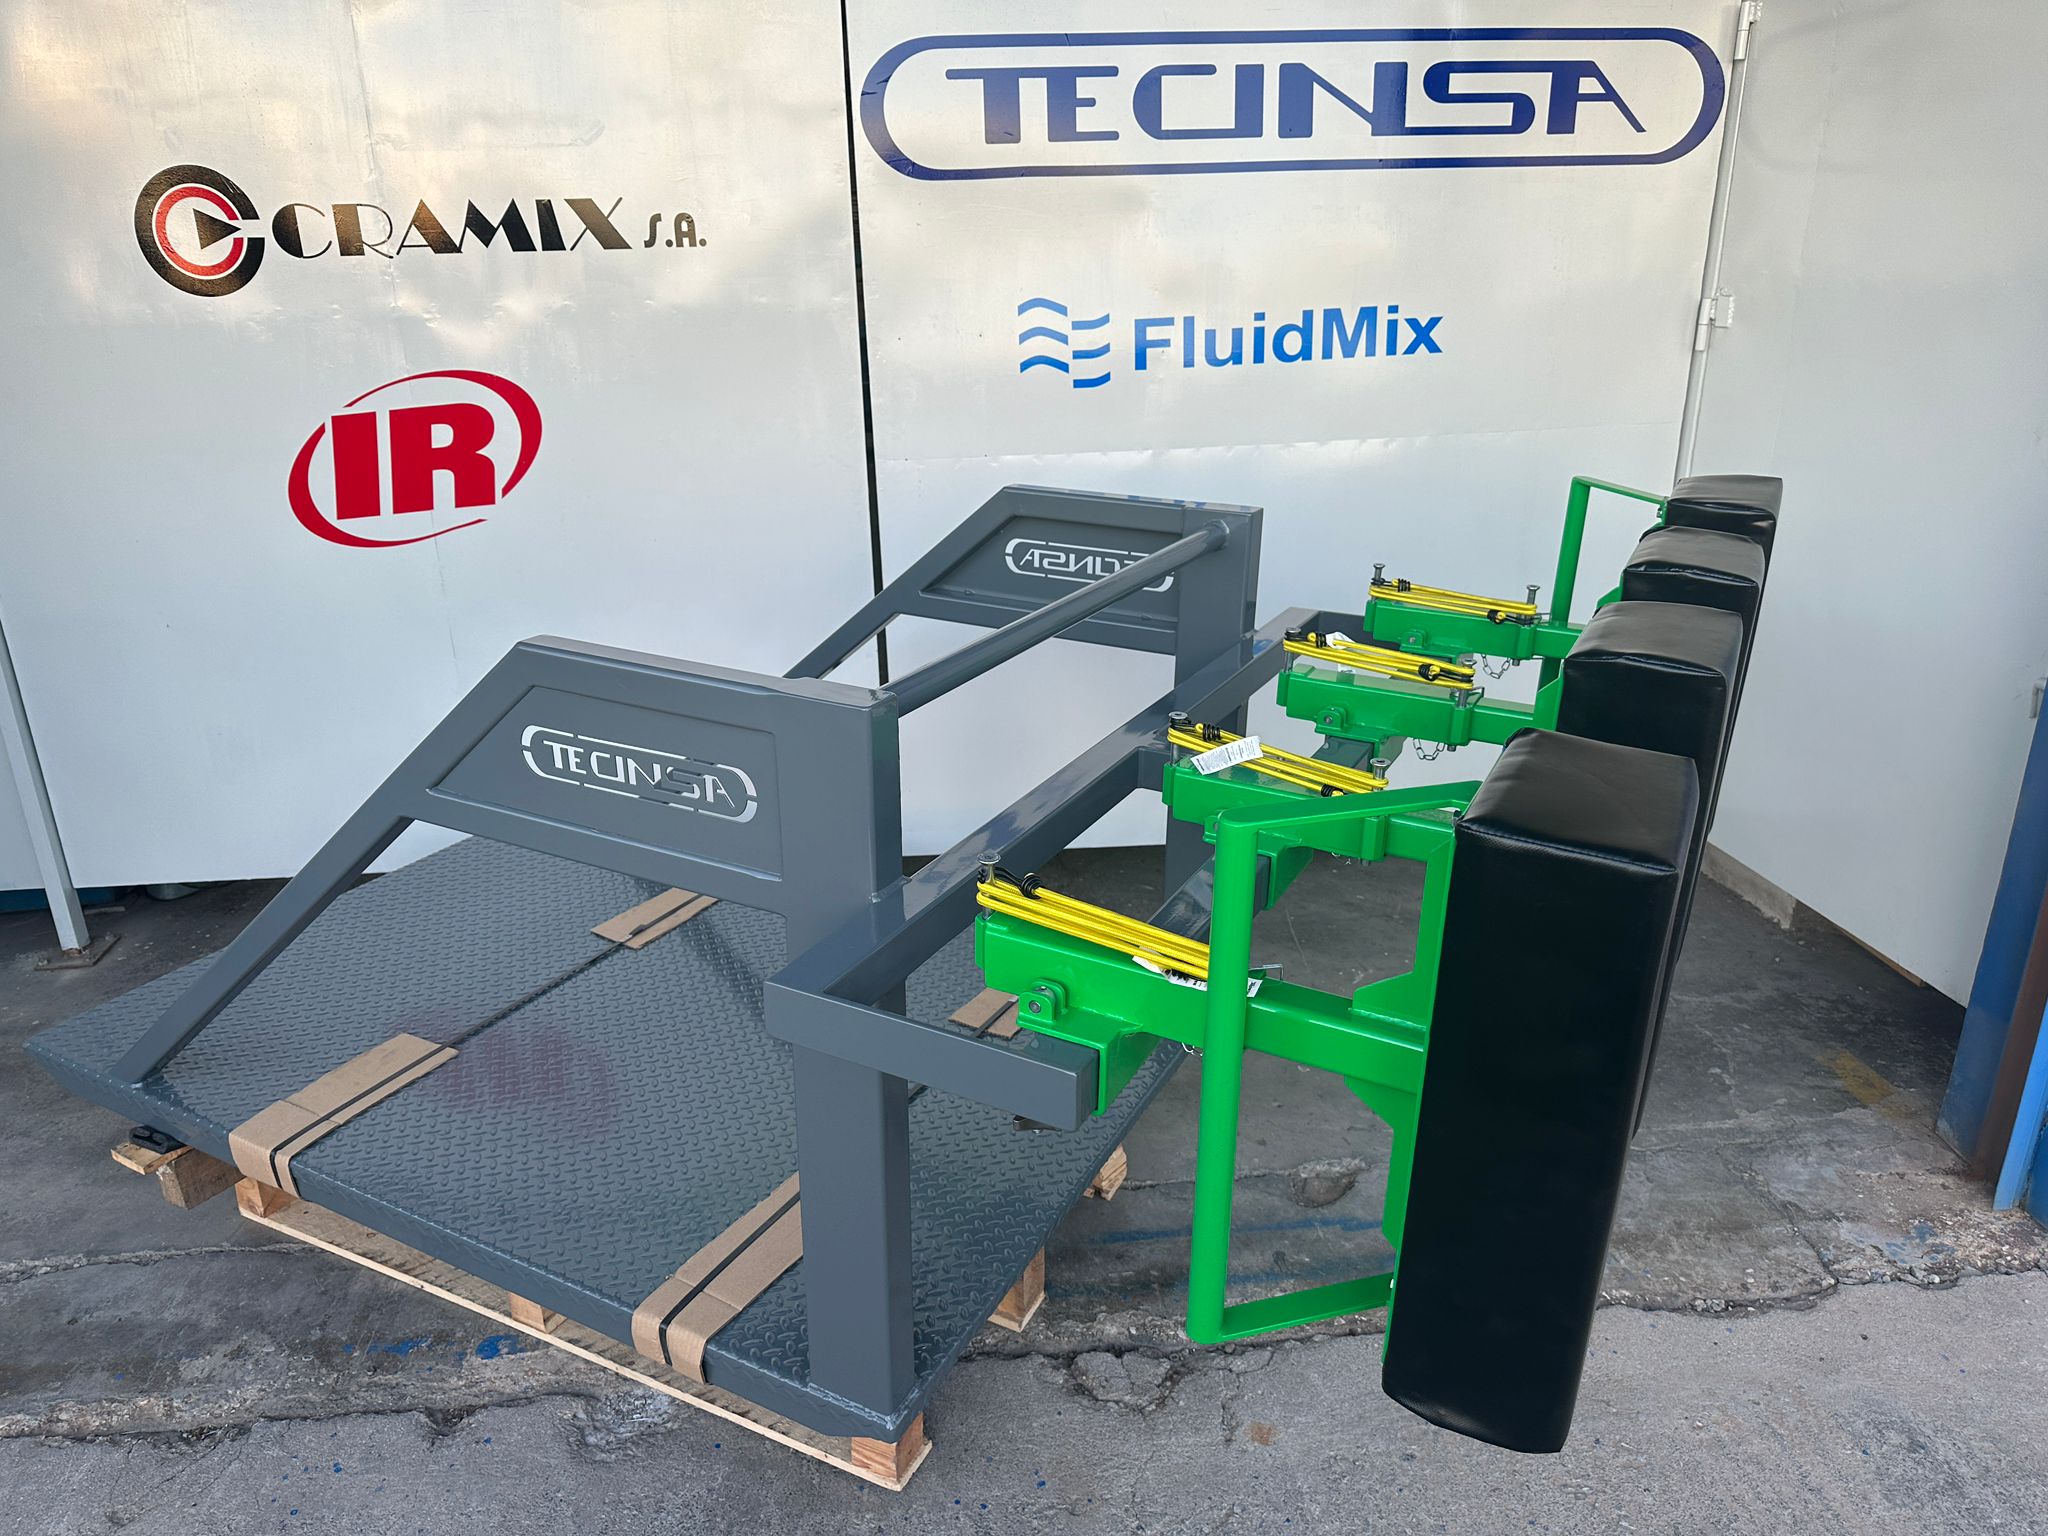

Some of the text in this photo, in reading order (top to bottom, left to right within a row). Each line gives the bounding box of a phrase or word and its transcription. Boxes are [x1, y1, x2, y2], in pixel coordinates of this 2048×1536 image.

[945, 60, 1648, 145] TECINSA
[272, 196, 707, 260] CRAMIX S.A.
[1134, 304, 1443, 372] FluidMix
[331, 402, 497, 521] IR
[543, 740, 735, 809] TECINSA
